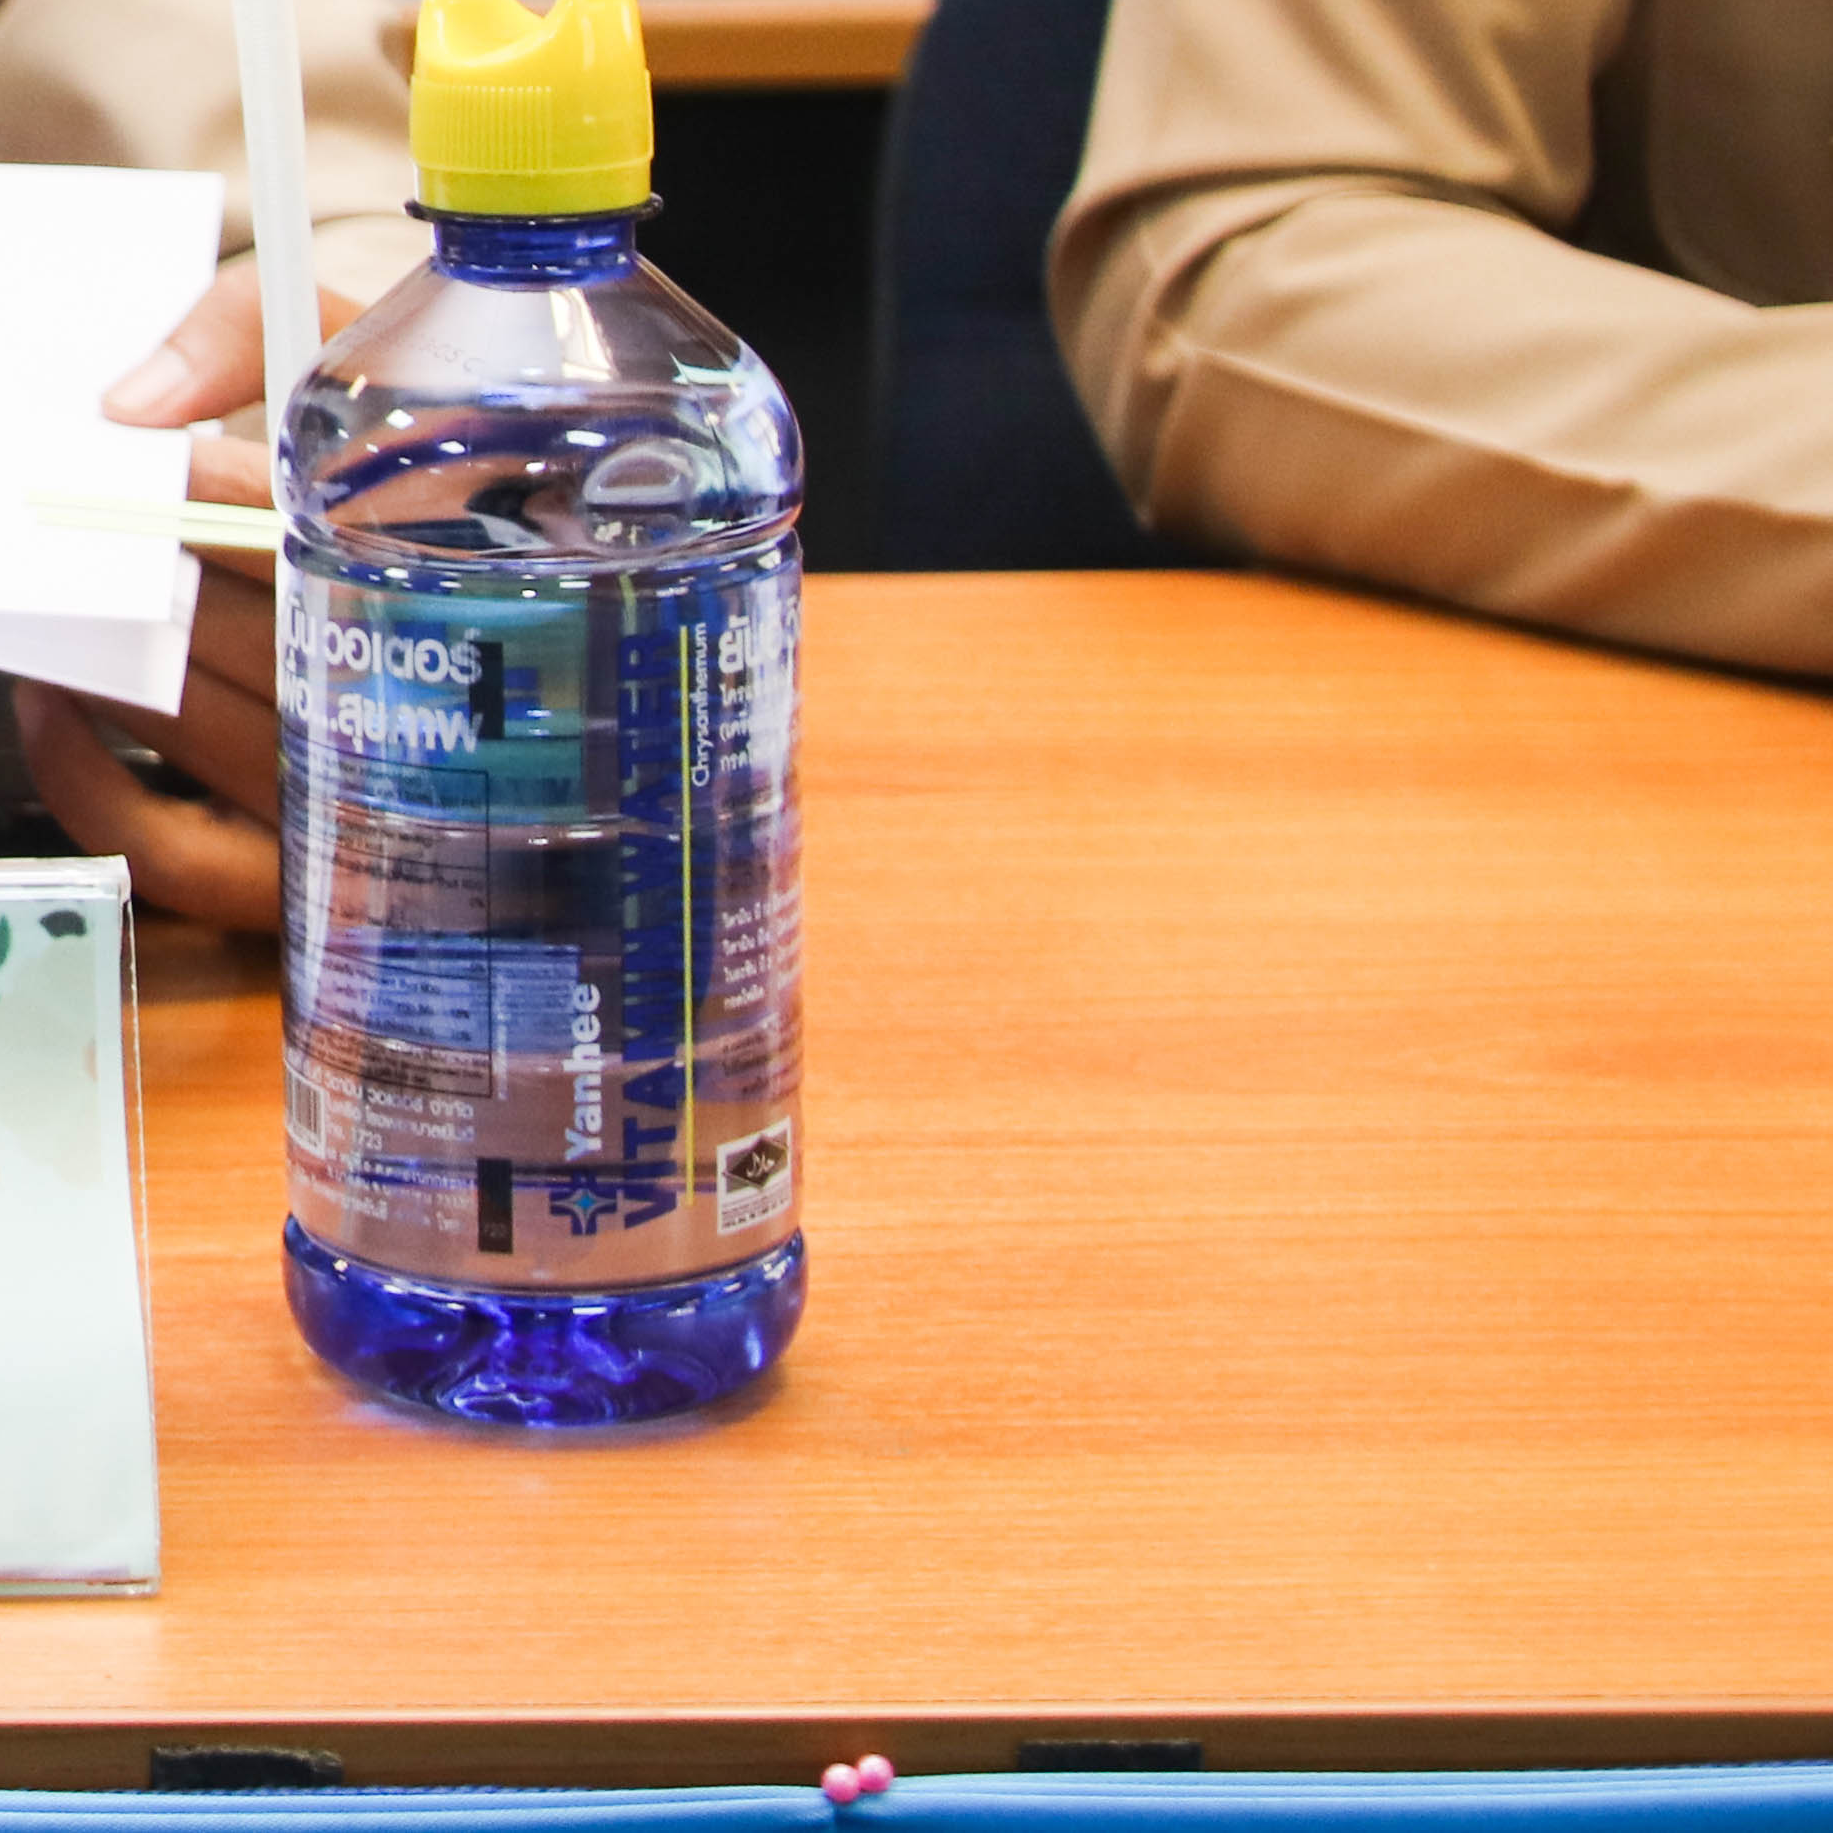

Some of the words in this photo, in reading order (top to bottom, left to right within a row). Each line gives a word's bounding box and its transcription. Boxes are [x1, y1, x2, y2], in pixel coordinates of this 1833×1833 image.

[618, 629, 675, 899] WATER
[690, 621, 714, 788] Chrysanthemum
[562, 982, 602, 1163] Yanhee
[621, 927, 678, 1230] VITAMIN
